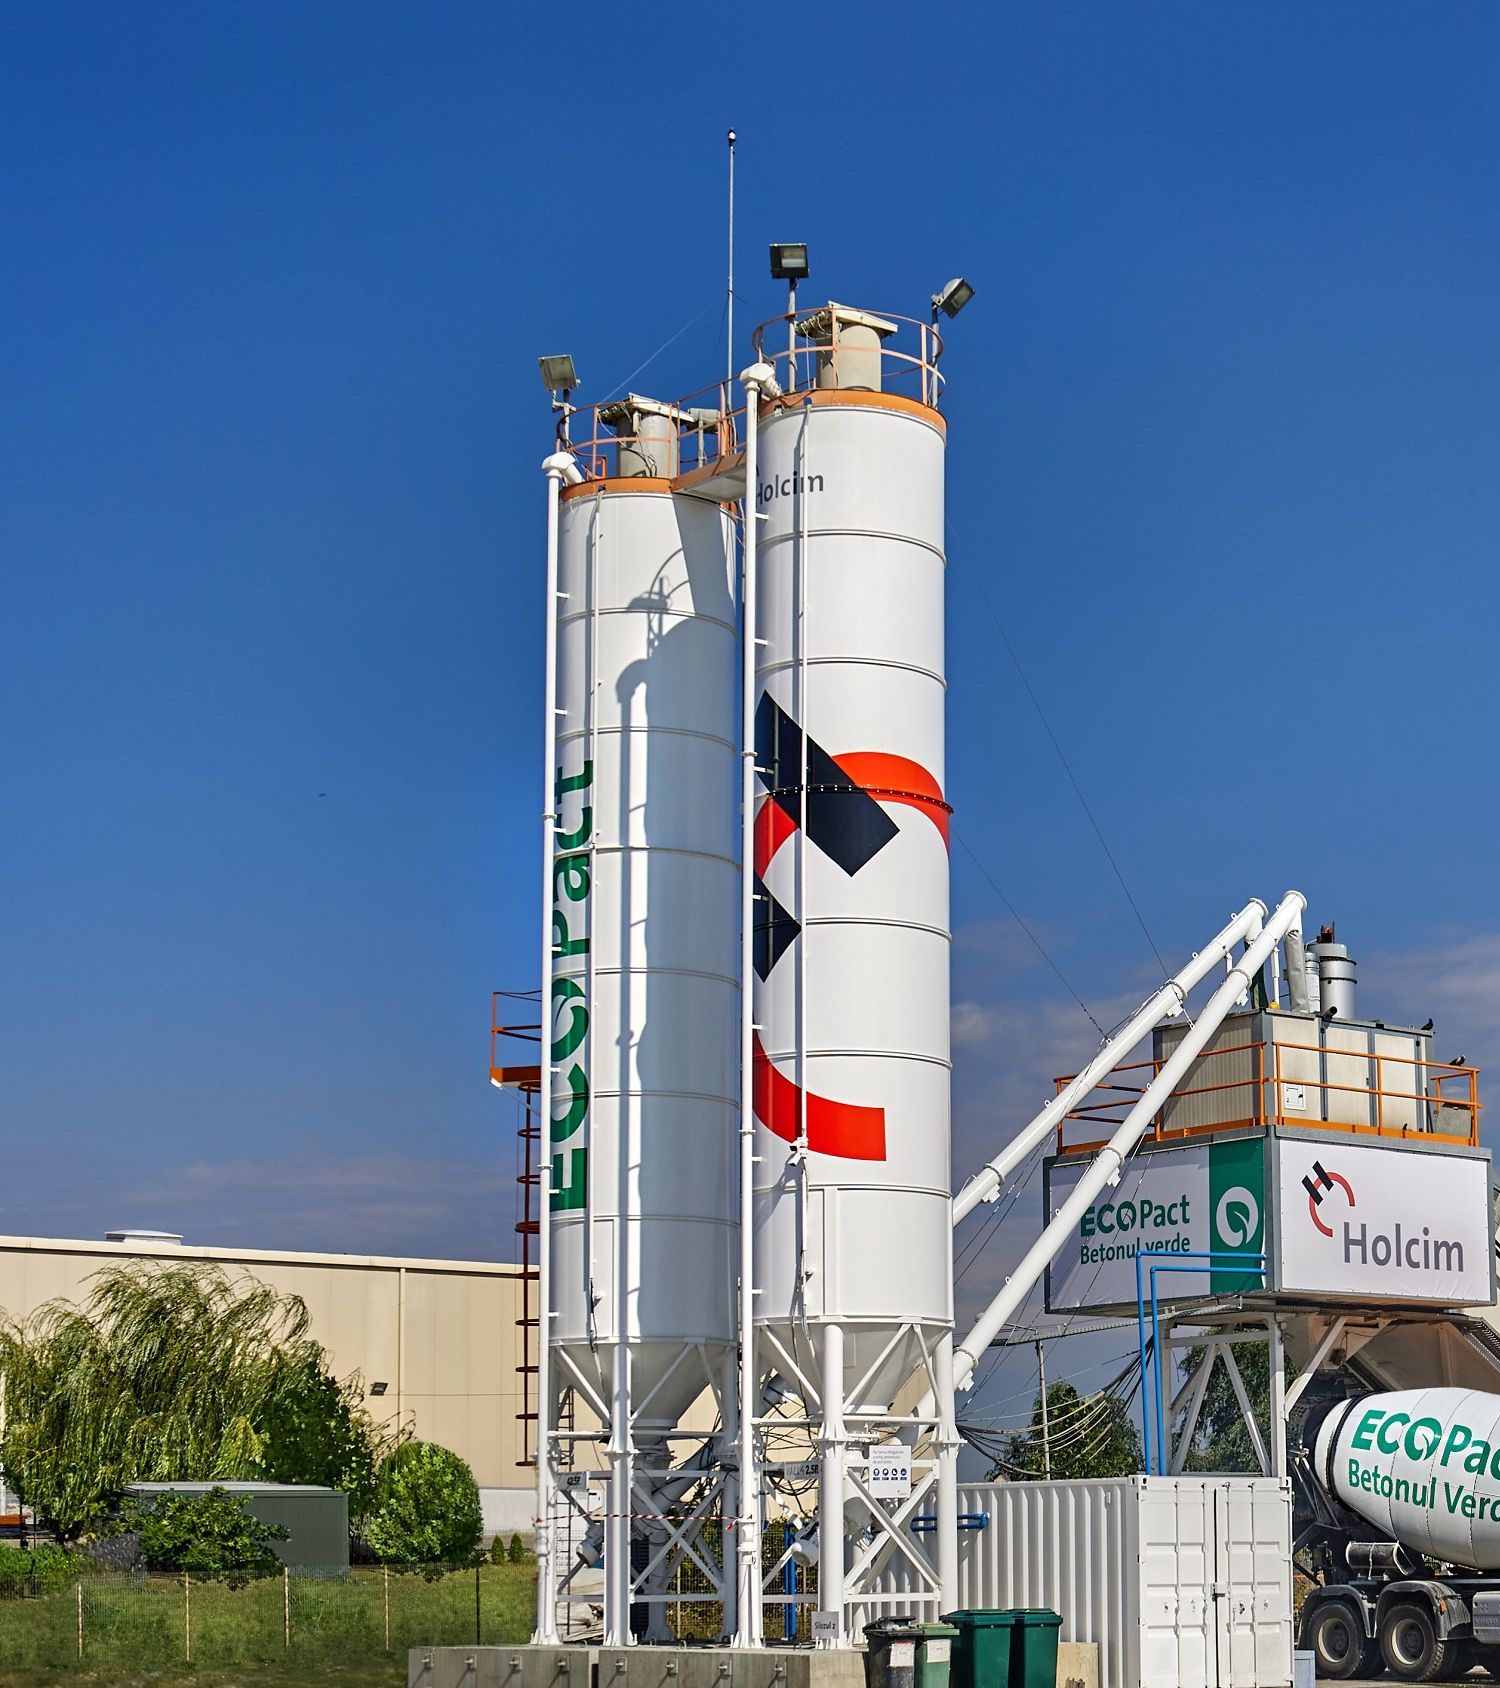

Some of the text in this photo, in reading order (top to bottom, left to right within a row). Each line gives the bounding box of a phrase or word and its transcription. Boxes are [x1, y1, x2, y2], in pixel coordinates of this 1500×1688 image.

[757, 470, 824, 507] Holcim
[549, 760, 593, 1212] ECOPact
[1080, 1194, 1190, 1237] ECOPact
[1080, 1231, 1191, 1265] Betonul verde
[1343, 1221, 1464, 1272] Holcim
[1348, 1458, 1436, 1509] Betonul
